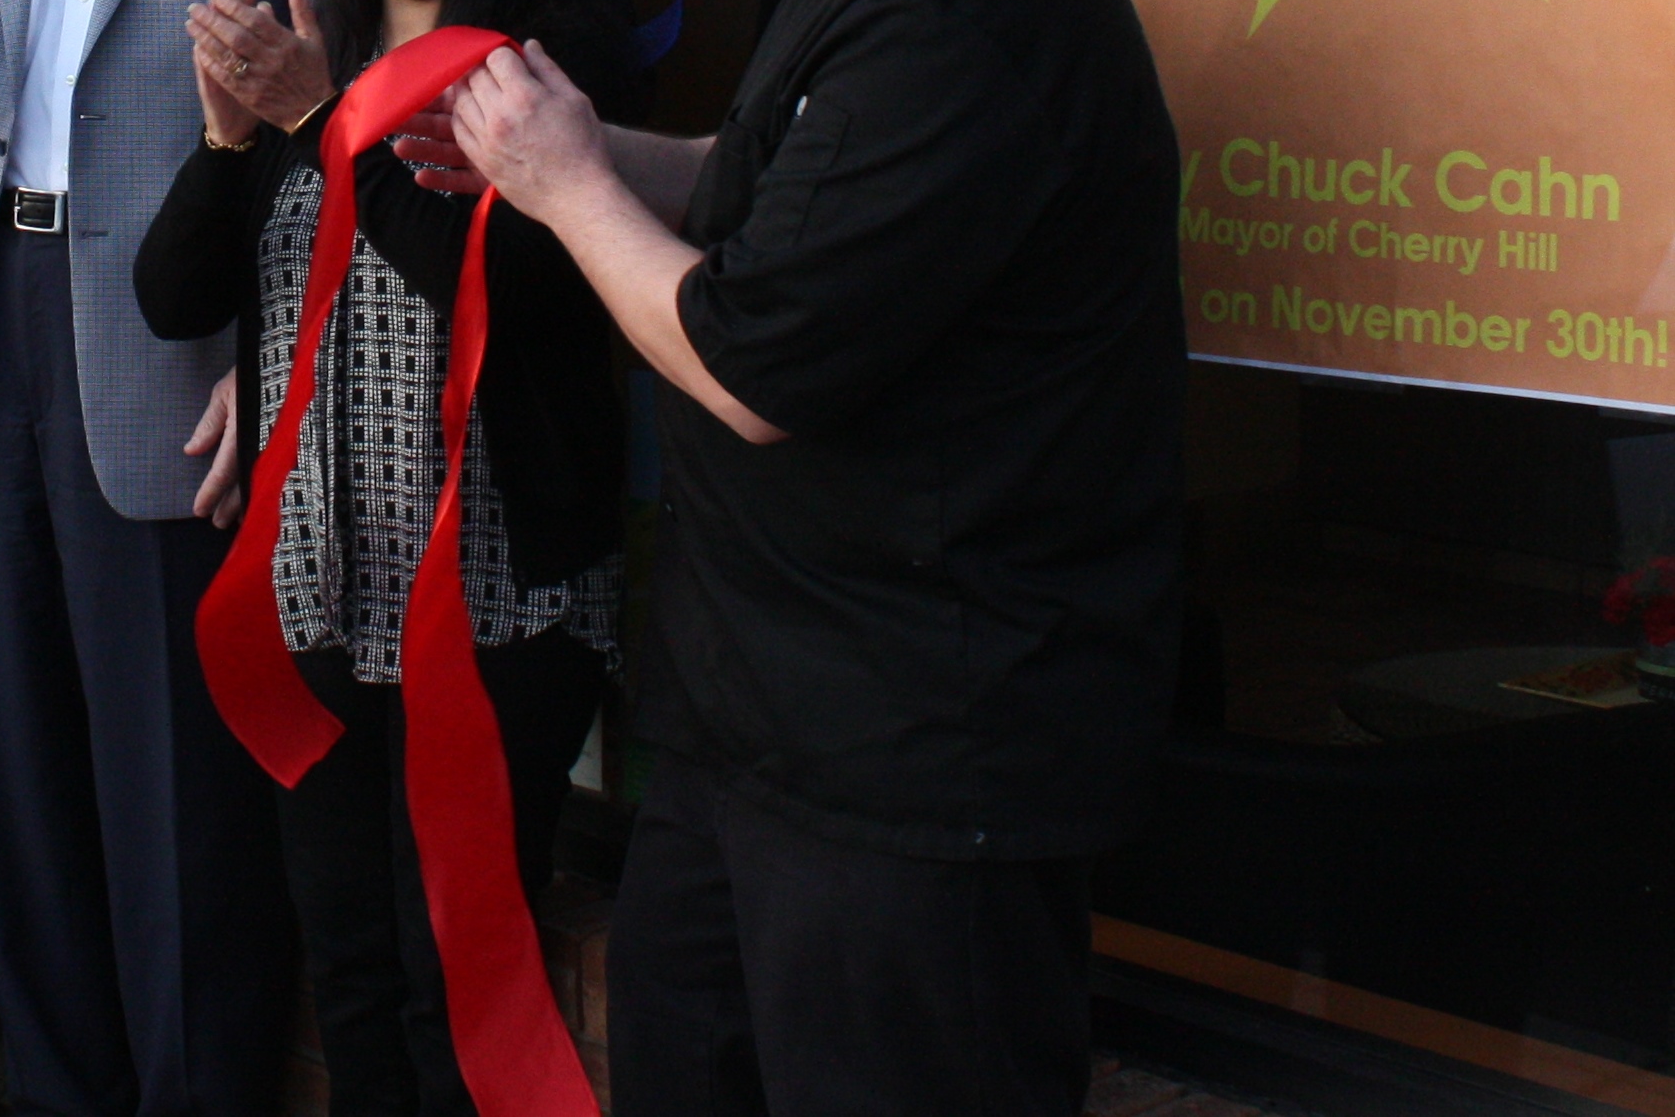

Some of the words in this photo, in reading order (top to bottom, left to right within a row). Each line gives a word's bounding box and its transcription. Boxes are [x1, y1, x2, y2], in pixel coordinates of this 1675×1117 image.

[1220, 137, 1414, 208] Chuck
[1435, 149, 1620, 221] Cahn
[1179, 206, 1295, 256] Mayor
[1303, 217, 1339, 254] of
[1348, 219, 1484, 275] Cherry
[1499, 230, 1558, 272] Hill
[1201, 288, 1257, 326] on
[1272, 284, 1532, 353] November
[1546, 309, 1668, 368] 30th!
